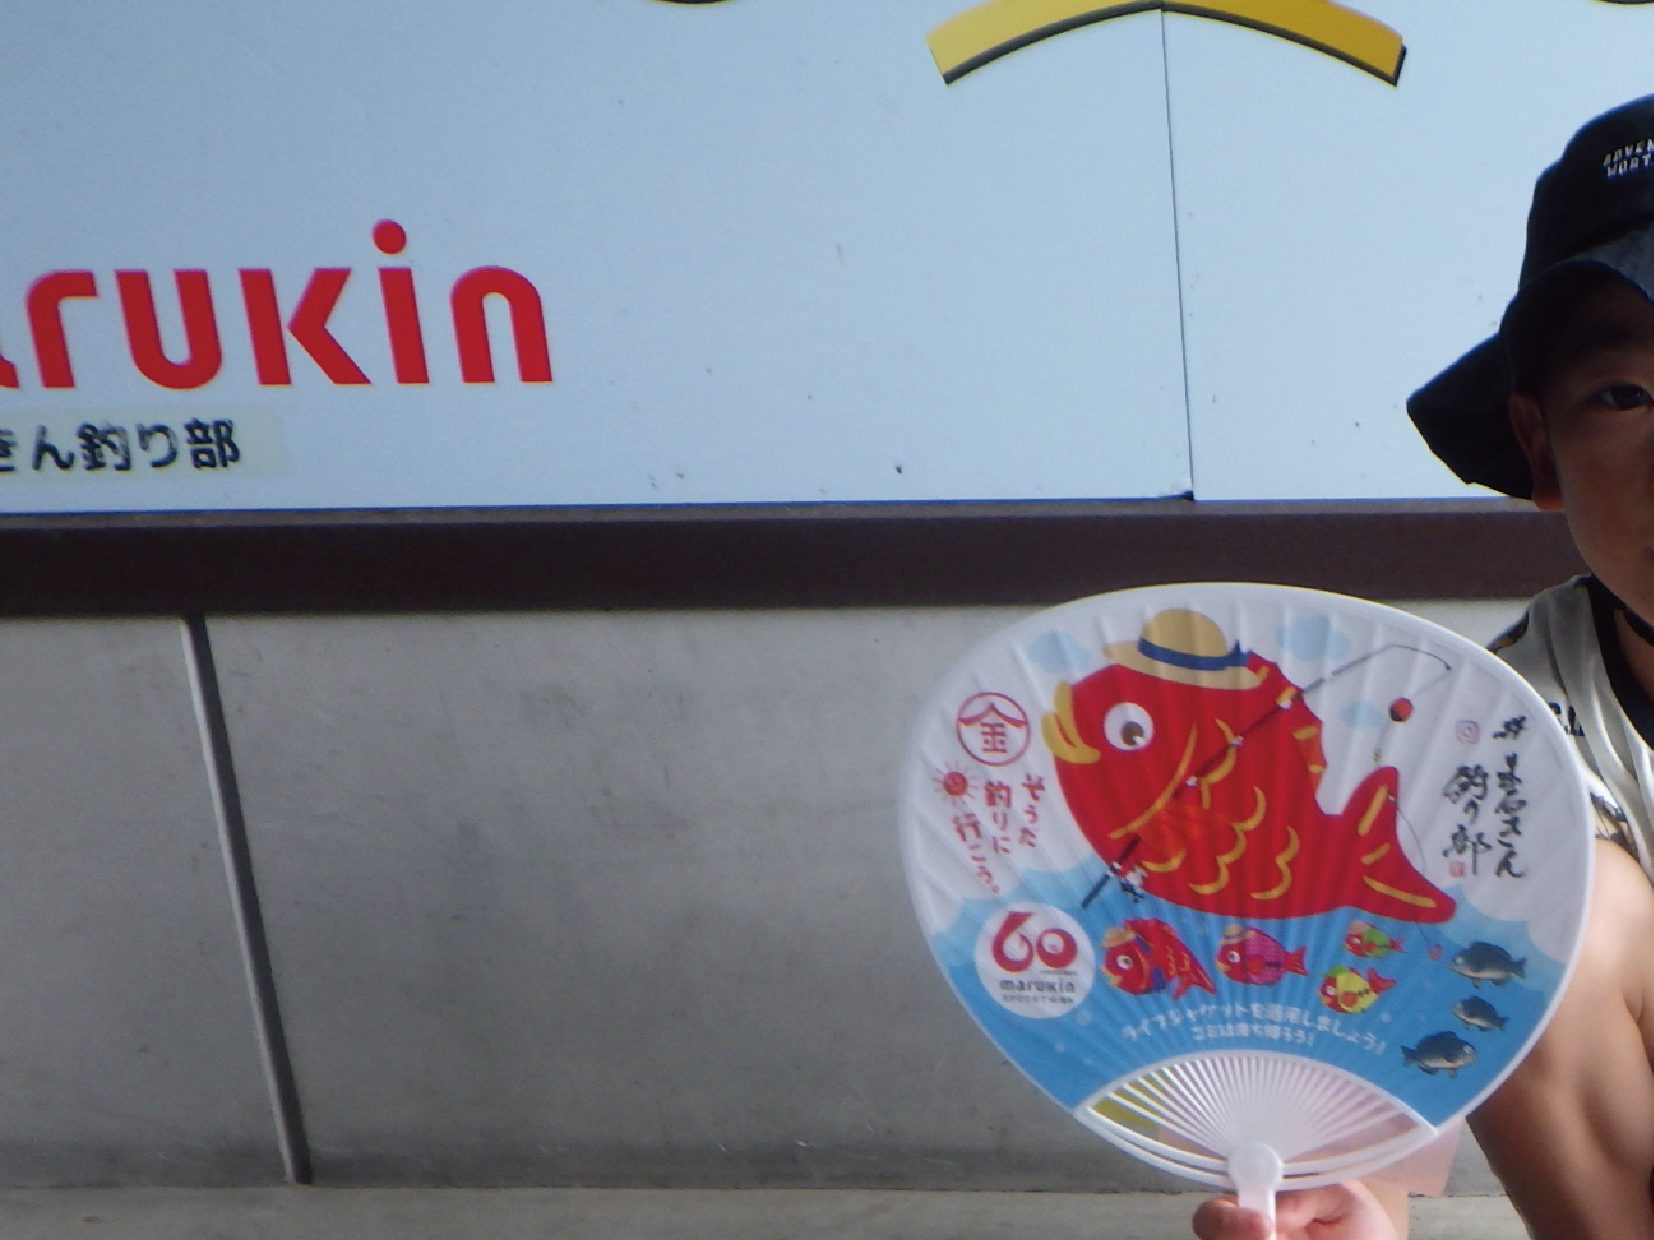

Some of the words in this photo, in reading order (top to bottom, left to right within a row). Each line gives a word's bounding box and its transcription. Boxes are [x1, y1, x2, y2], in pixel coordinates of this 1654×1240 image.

[0, 217, 553, 390] rukin
[984, 779, 1012, 855] 釣りに
[991, 911, 1078, 972] 60
